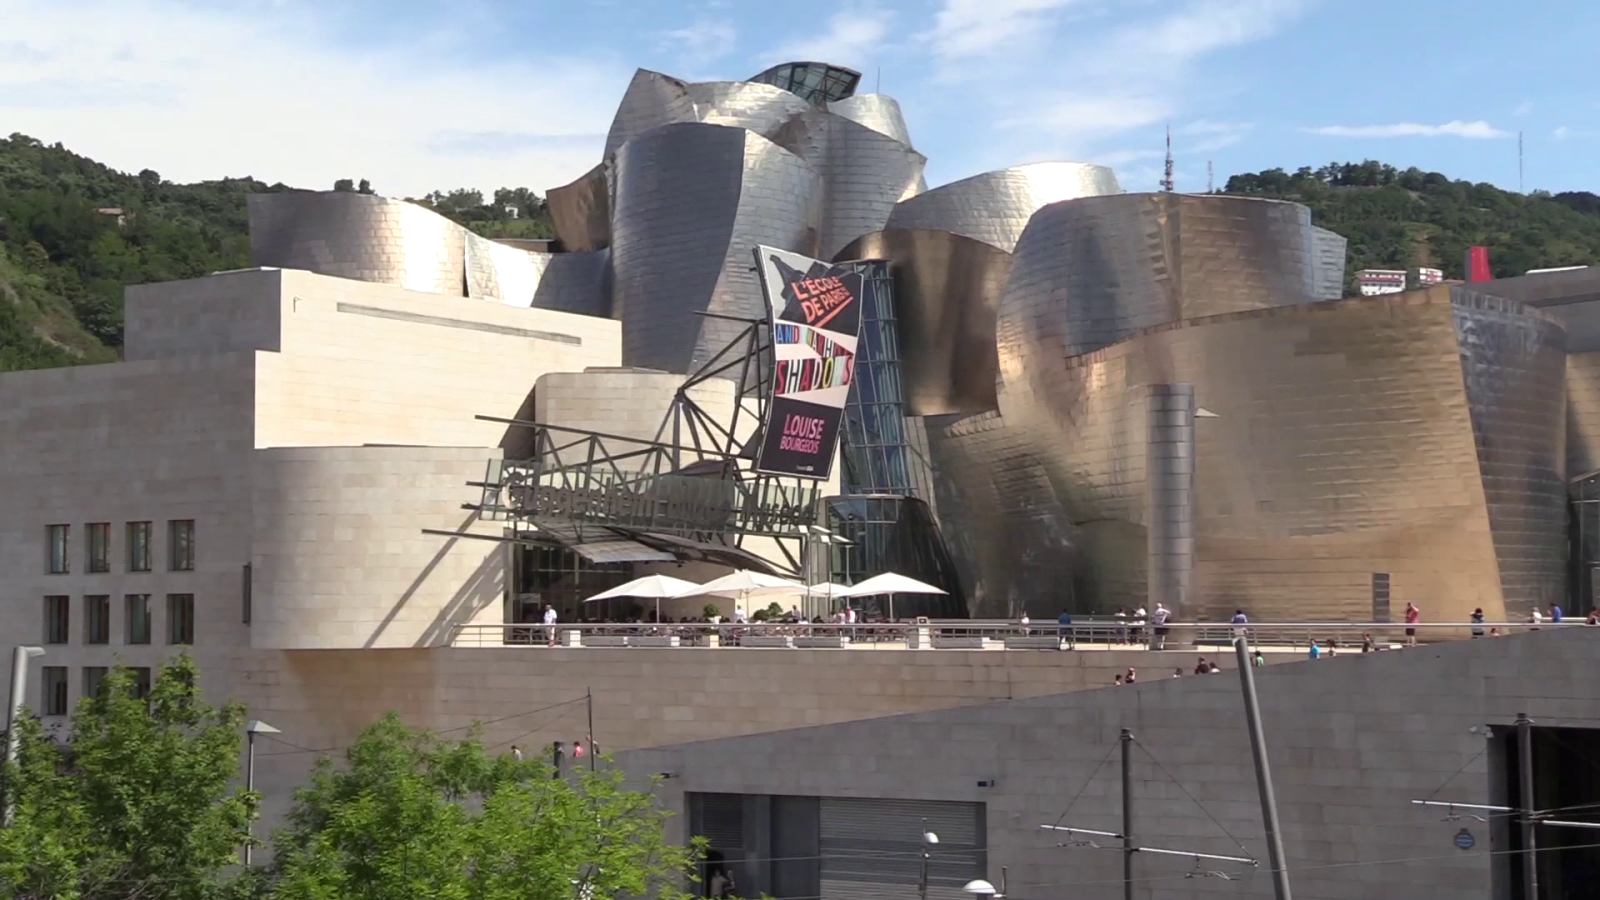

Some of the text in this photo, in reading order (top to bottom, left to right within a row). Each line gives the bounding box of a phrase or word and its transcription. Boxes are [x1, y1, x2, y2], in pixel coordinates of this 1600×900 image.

[801, 298, 824, 323] DE
[775, 355, 852, 394] SHADOWS
[784, 413, 824, 439] LOUISE
[780, 435, 820, 454] BOURGEOIS
